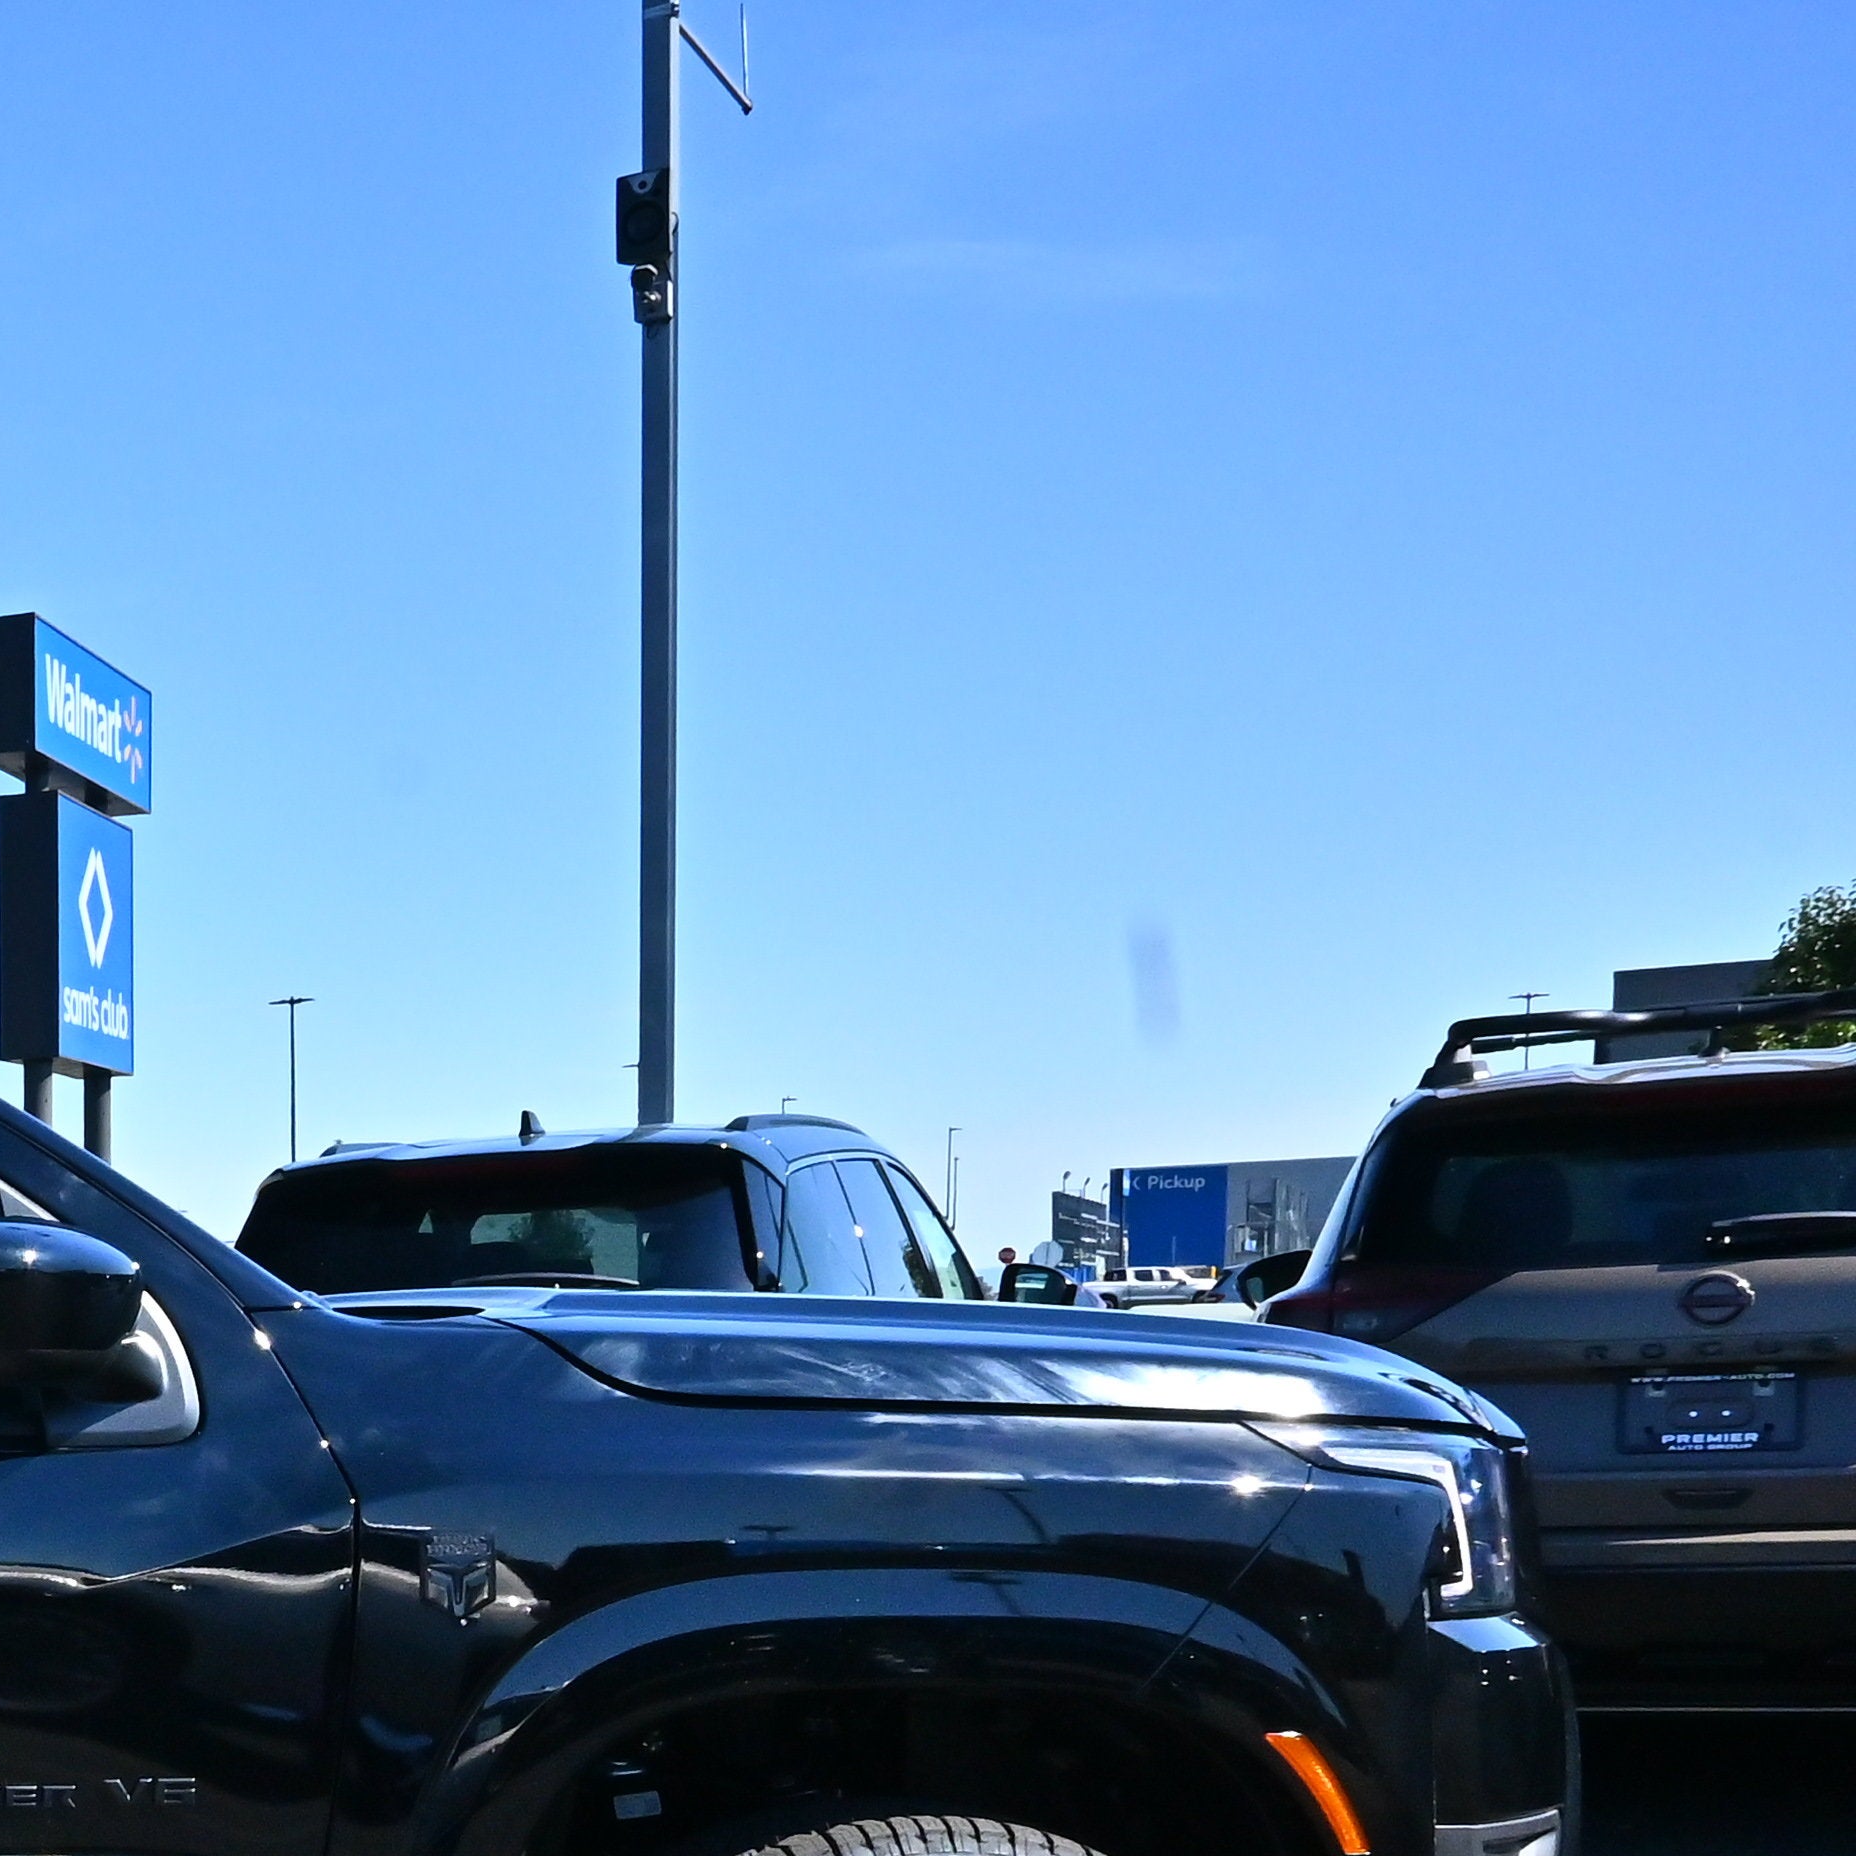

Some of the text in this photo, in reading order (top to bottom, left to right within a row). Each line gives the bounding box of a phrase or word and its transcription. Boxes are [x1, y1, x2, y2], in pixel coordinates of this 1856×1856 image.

[45, 653, 122, 764] Walmart
[63, 986, 128, 1040] sam's club
[1147, 1175, 1206, 1192] Pickup
[1661, 1432, 1759, 1444] PREMIER
